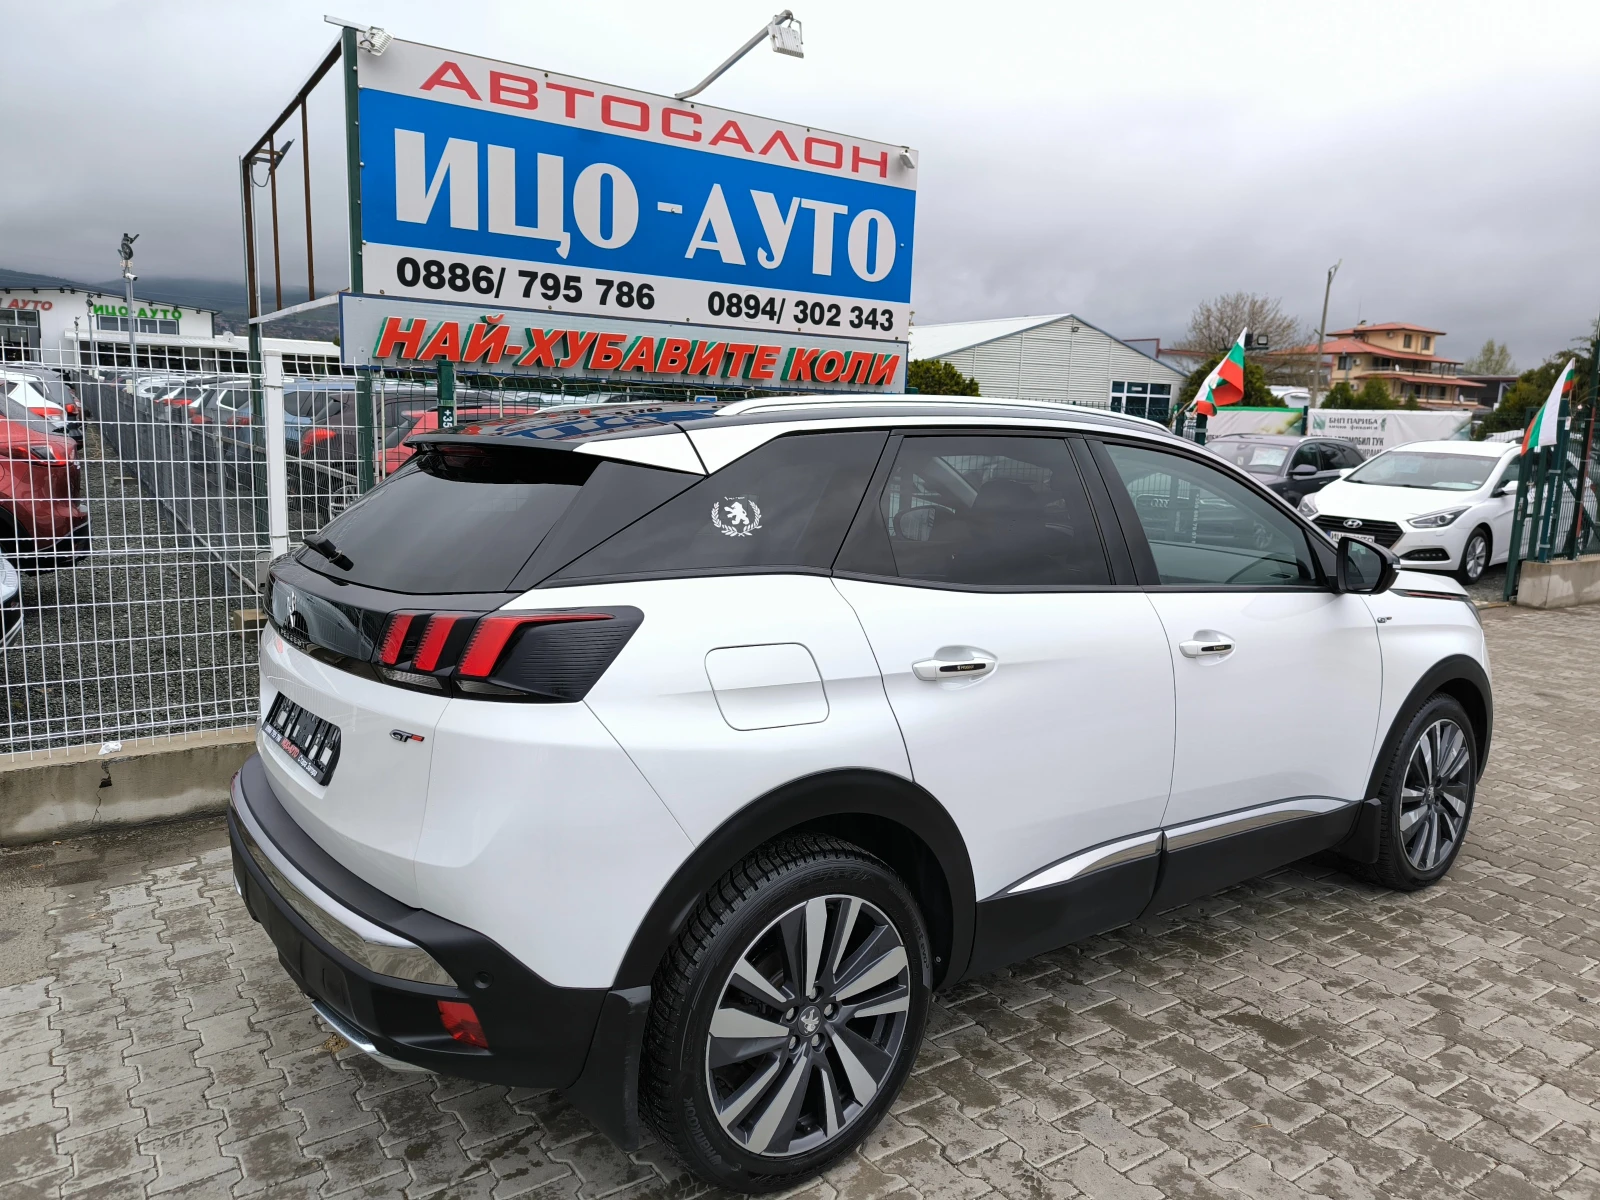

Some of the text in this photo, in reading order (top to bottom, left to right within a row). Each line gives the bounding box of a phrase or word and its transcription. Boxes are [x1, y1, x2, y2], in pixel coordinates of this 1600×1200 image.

[420, 61, 888, 179] АВТОСАЛОН
[397, 257, 894, 332] 0886/ 795 786 0894/ 302 343
[780, 347, 900, 386] КОЛИ
